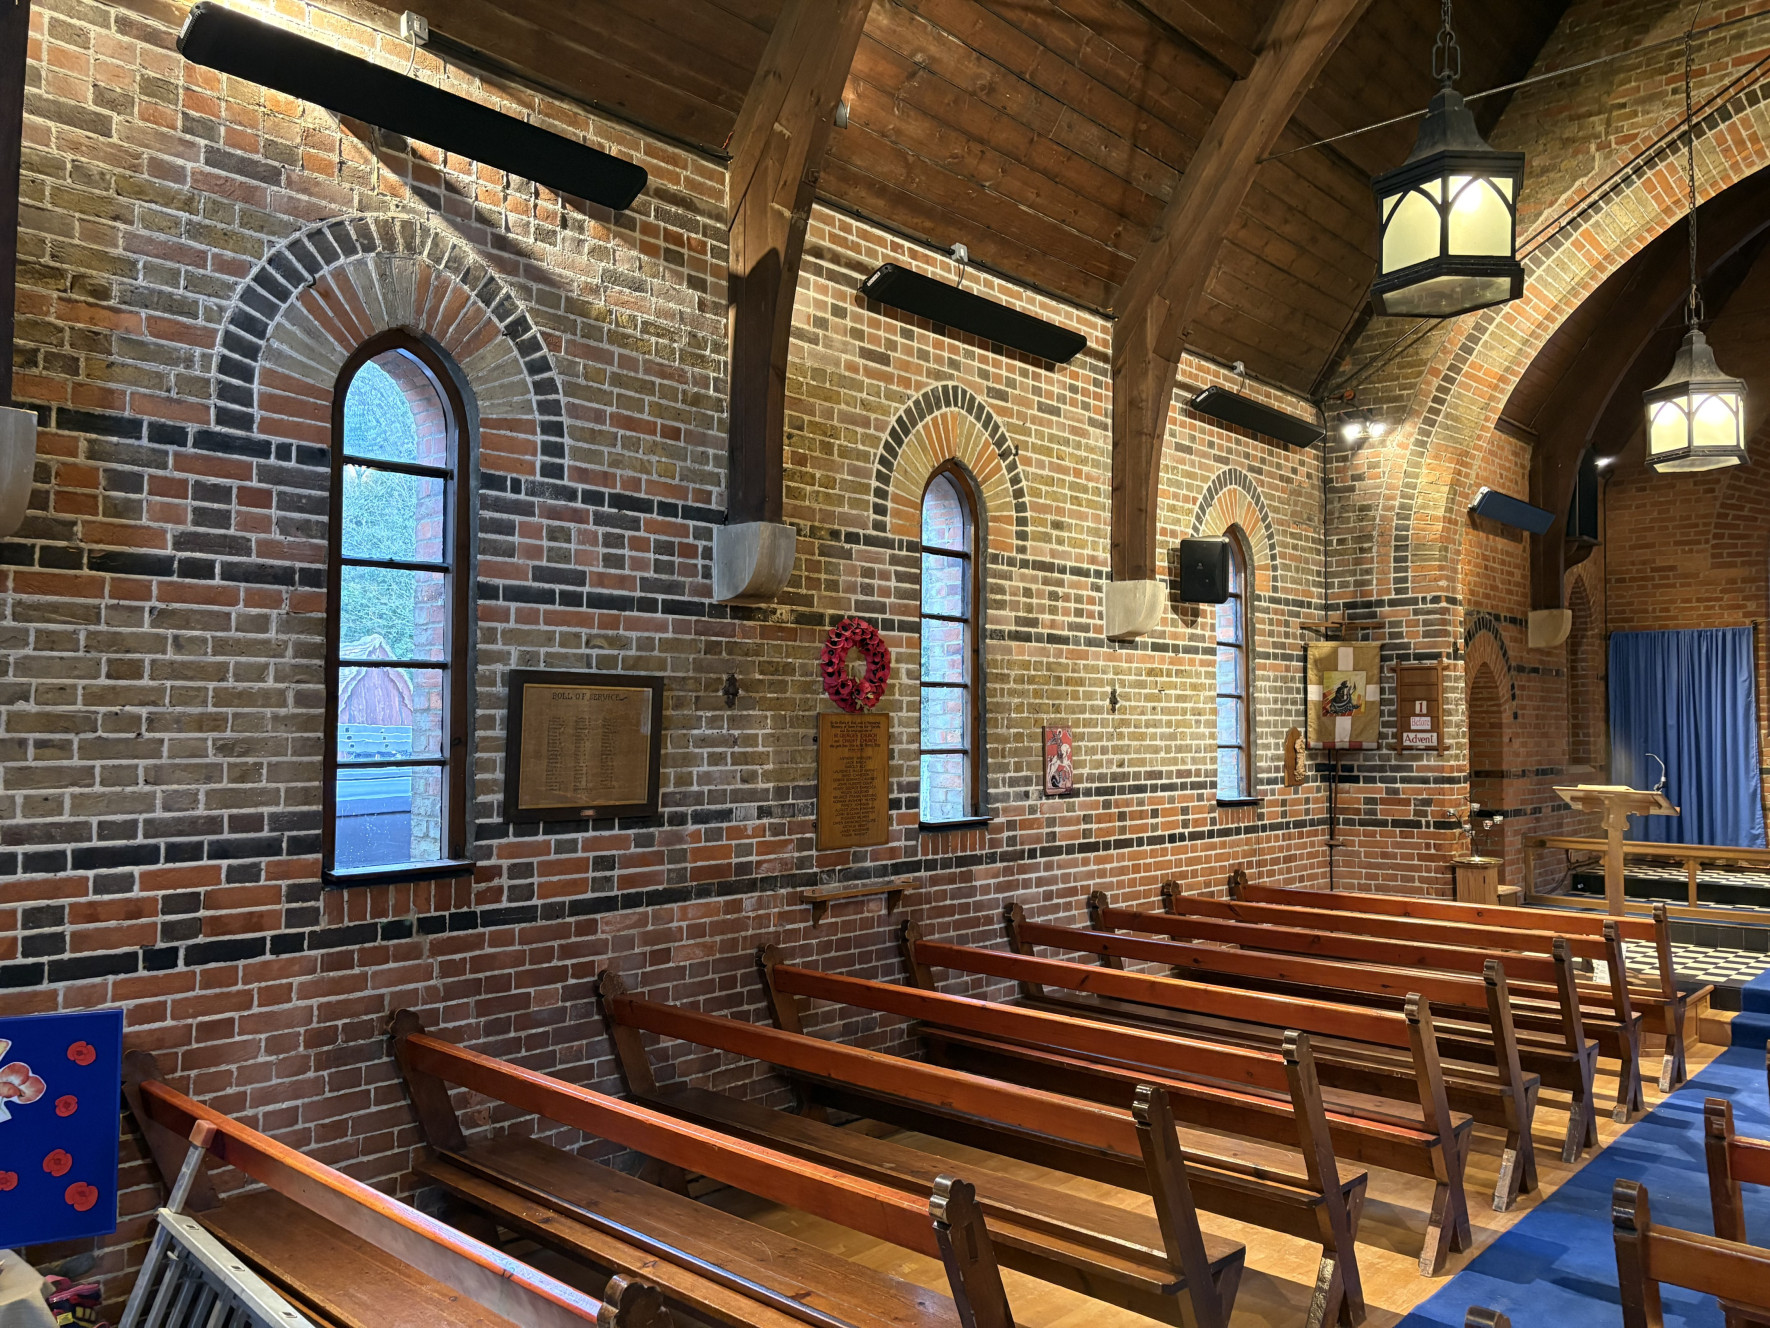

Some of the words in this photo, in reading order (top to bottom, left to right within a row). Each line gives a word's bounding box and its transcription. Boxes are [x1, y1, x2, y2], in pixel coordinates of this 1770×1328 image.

[552, 692, 573, 700] ROLL
[576, 692, 587, 700] OF
[1418, 702, 1423, 714] 1
[1412, 718, 1430, 726] Before
[1404, 734, 1434, 744] Advent
